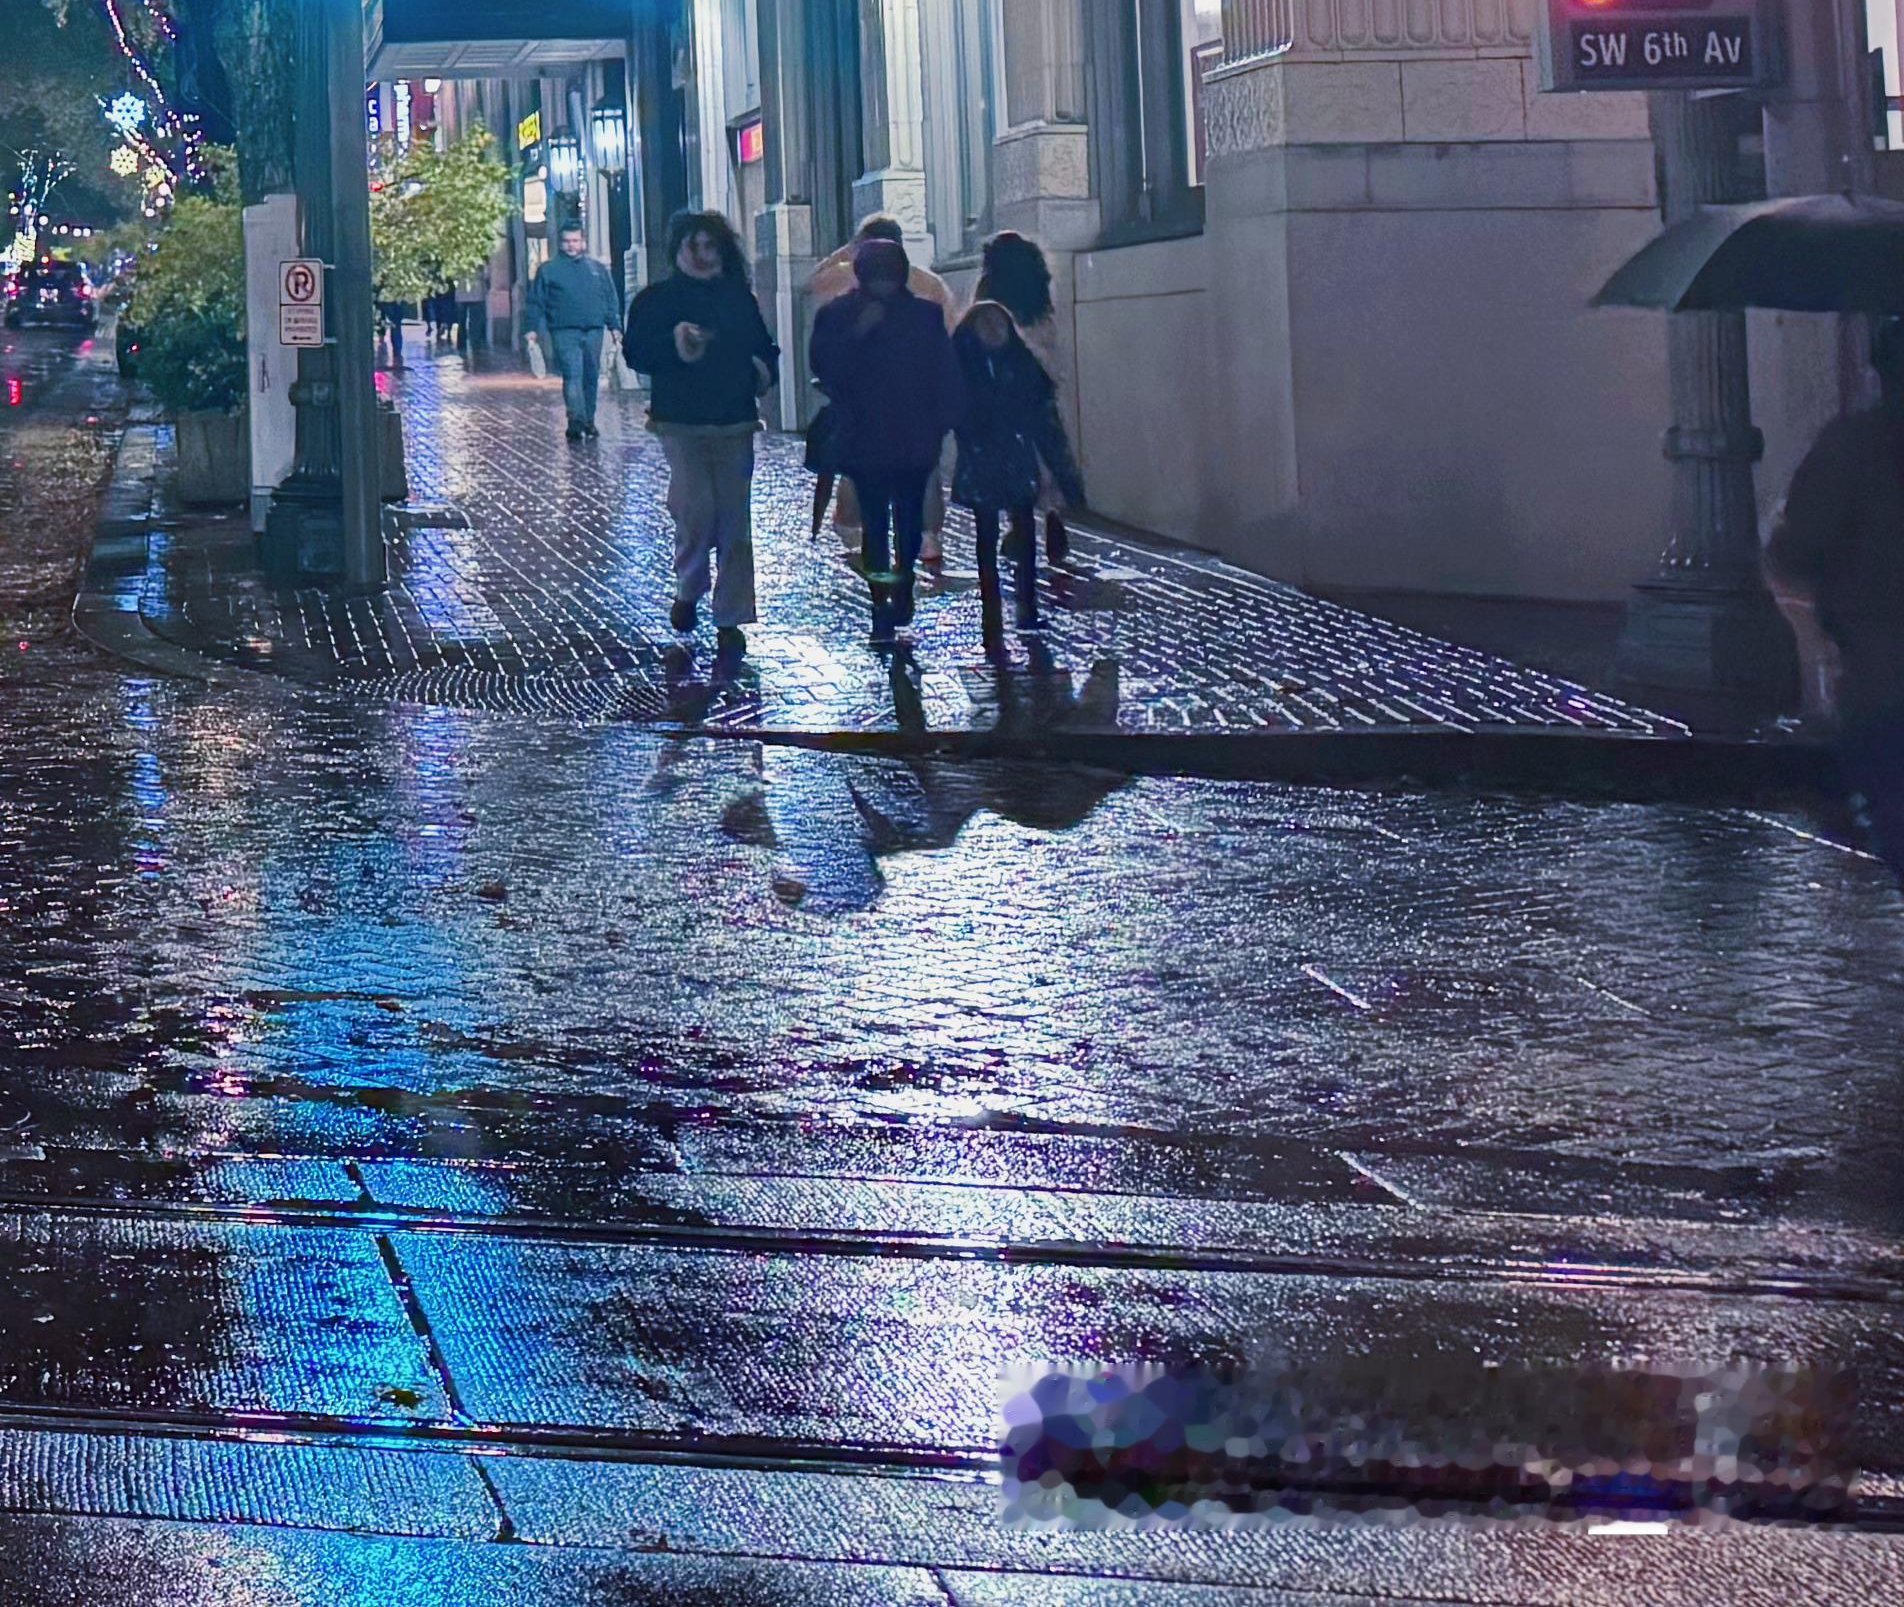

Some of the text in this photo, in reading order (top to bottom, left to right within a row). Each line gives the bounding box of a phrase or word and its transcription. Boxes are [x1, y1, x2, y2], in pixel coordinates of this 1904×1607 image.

[1579, 31, 1742, 67] SW 6th Av
